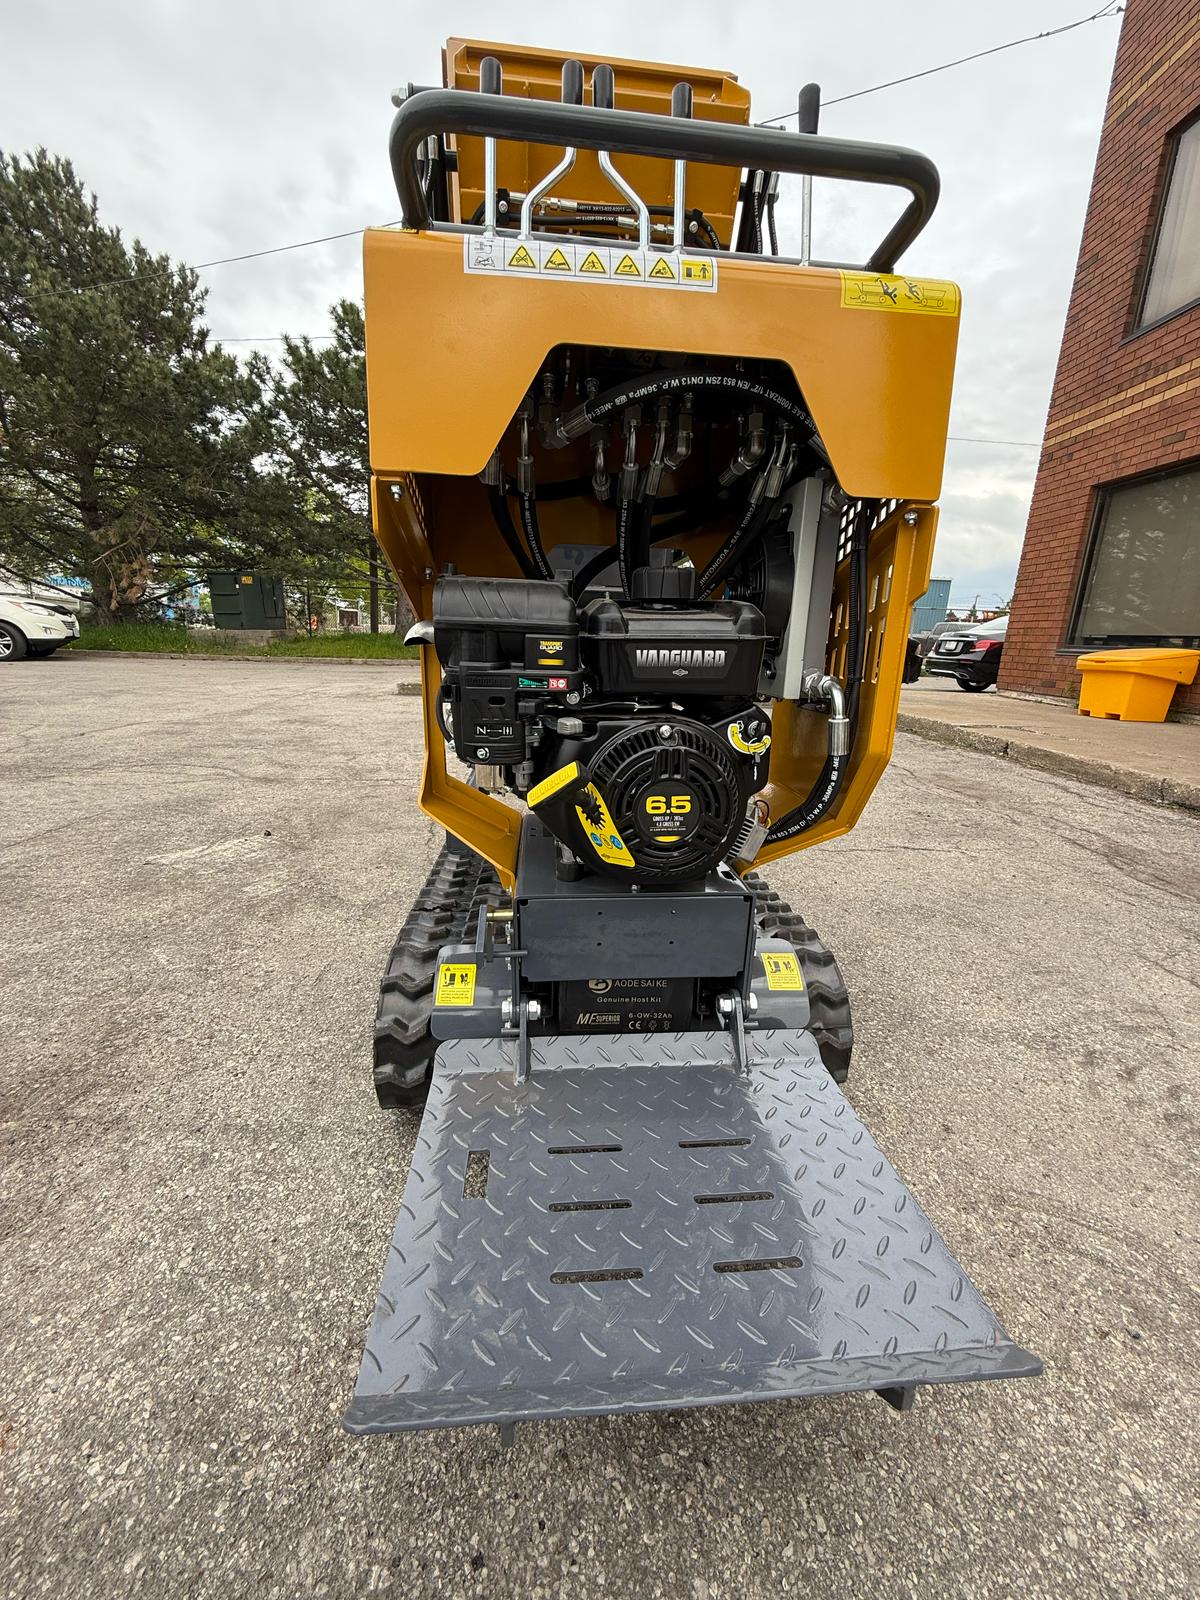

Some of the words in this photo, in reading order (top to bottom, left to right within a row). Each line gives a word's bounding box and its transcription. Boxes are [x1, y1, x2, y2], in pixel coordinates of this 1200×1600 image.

[682, 376, 704, 386] DN13
[706, 376, 722, 384] 2SN
[723, 376, 736, 386] 853
[628, 384, 658, 398] 36MPa
[764, 389, 792, 410] 100R2AT
[636, 650, 726, 667] VANGUARD
[646, 796, 692, 814] 6.5
